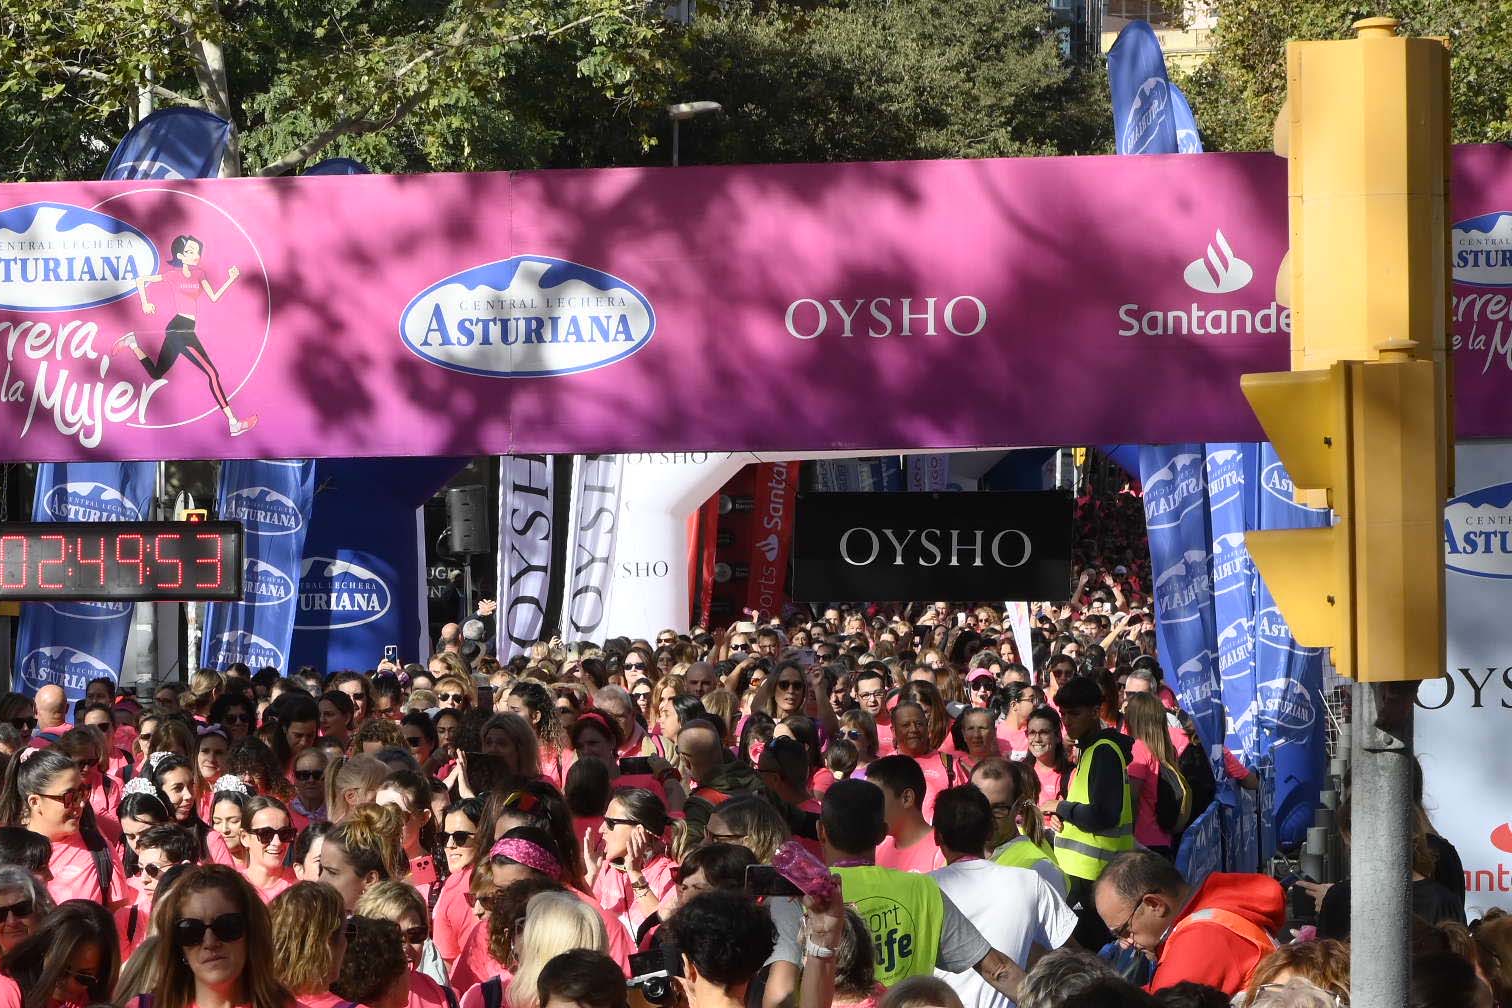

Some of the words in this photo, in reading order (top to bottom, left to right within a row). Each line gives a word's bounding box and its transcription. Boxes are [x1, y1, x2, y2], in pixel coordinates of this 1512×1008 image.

[419, 303, 636, 348] ASTURIANA
[459, 297, 538, 313] CENTRAL
[545, 295, 628, 310] LECHERA
[784, 294, 988, 340] OYSHO
[1118, 301, 1294, 337] Santande
[0, 363, 25, 403] la
[20, 355, 169, 449] Mujer
[0, 533, 224, 589] 02:49:53
[507, 455, 551, 648] OYSH
[569, 455, 617, 634] OYSH
[839, 527, 1032, 568] OYSHO
[874, 928, 913, 973] ife
